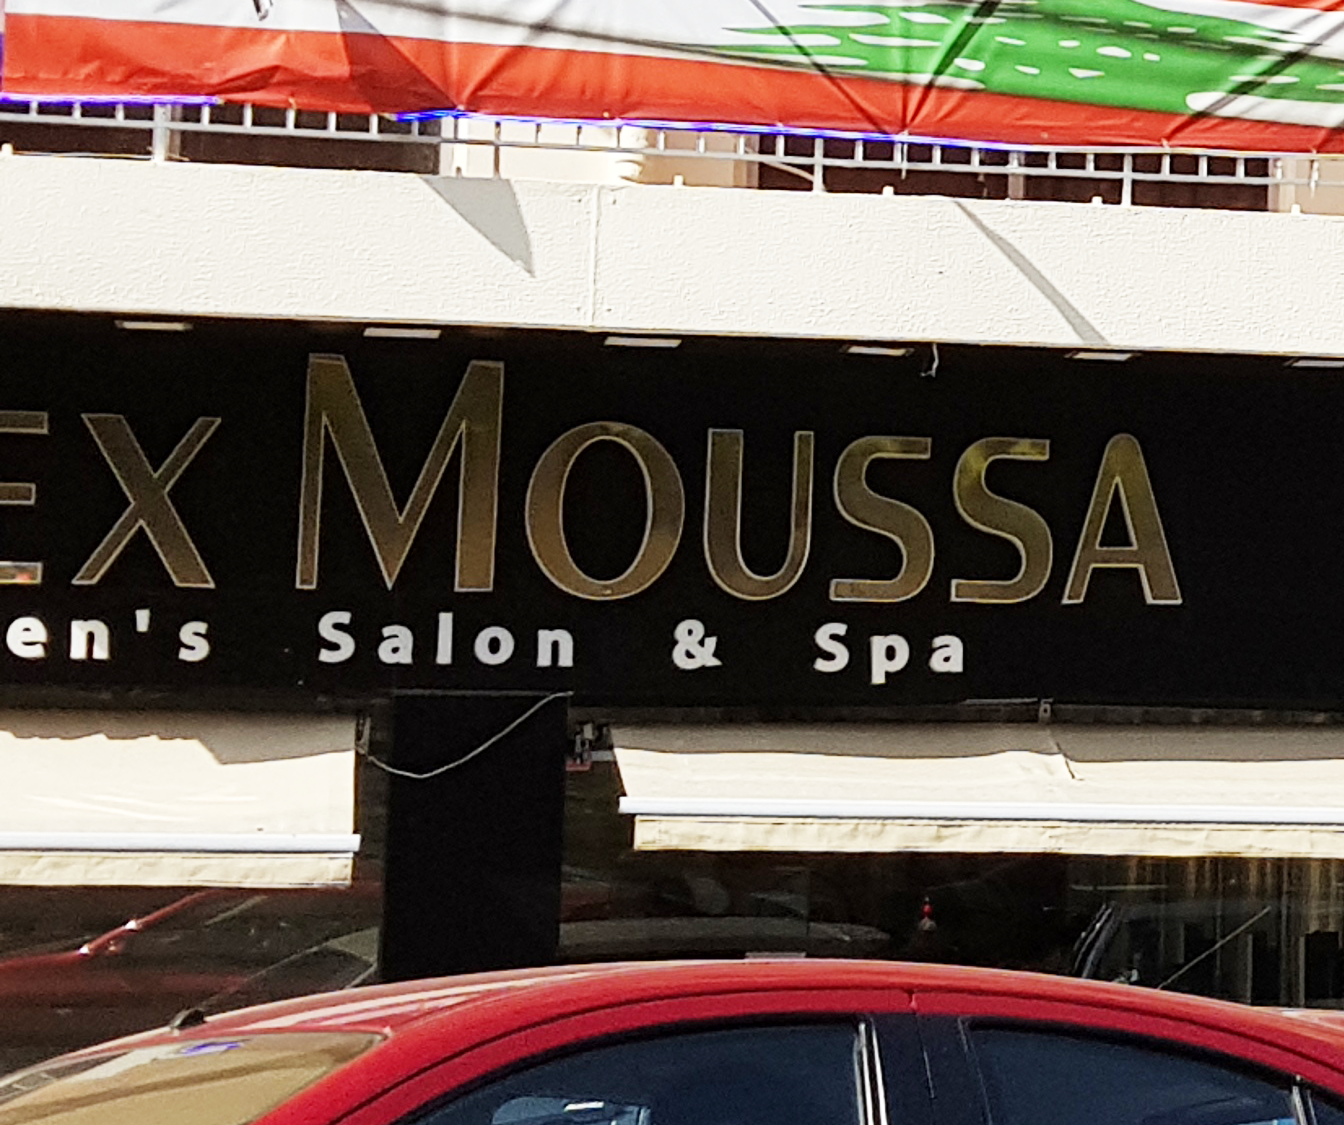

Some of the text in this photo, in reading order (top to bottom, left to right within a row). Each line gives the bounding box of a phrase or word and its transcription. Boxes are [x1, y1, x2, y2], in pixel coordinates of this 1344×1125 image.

[318, 609, 577, 669] Salon
[672, 618, 722, 671] &
[813, 621, 966, 684] Spa
